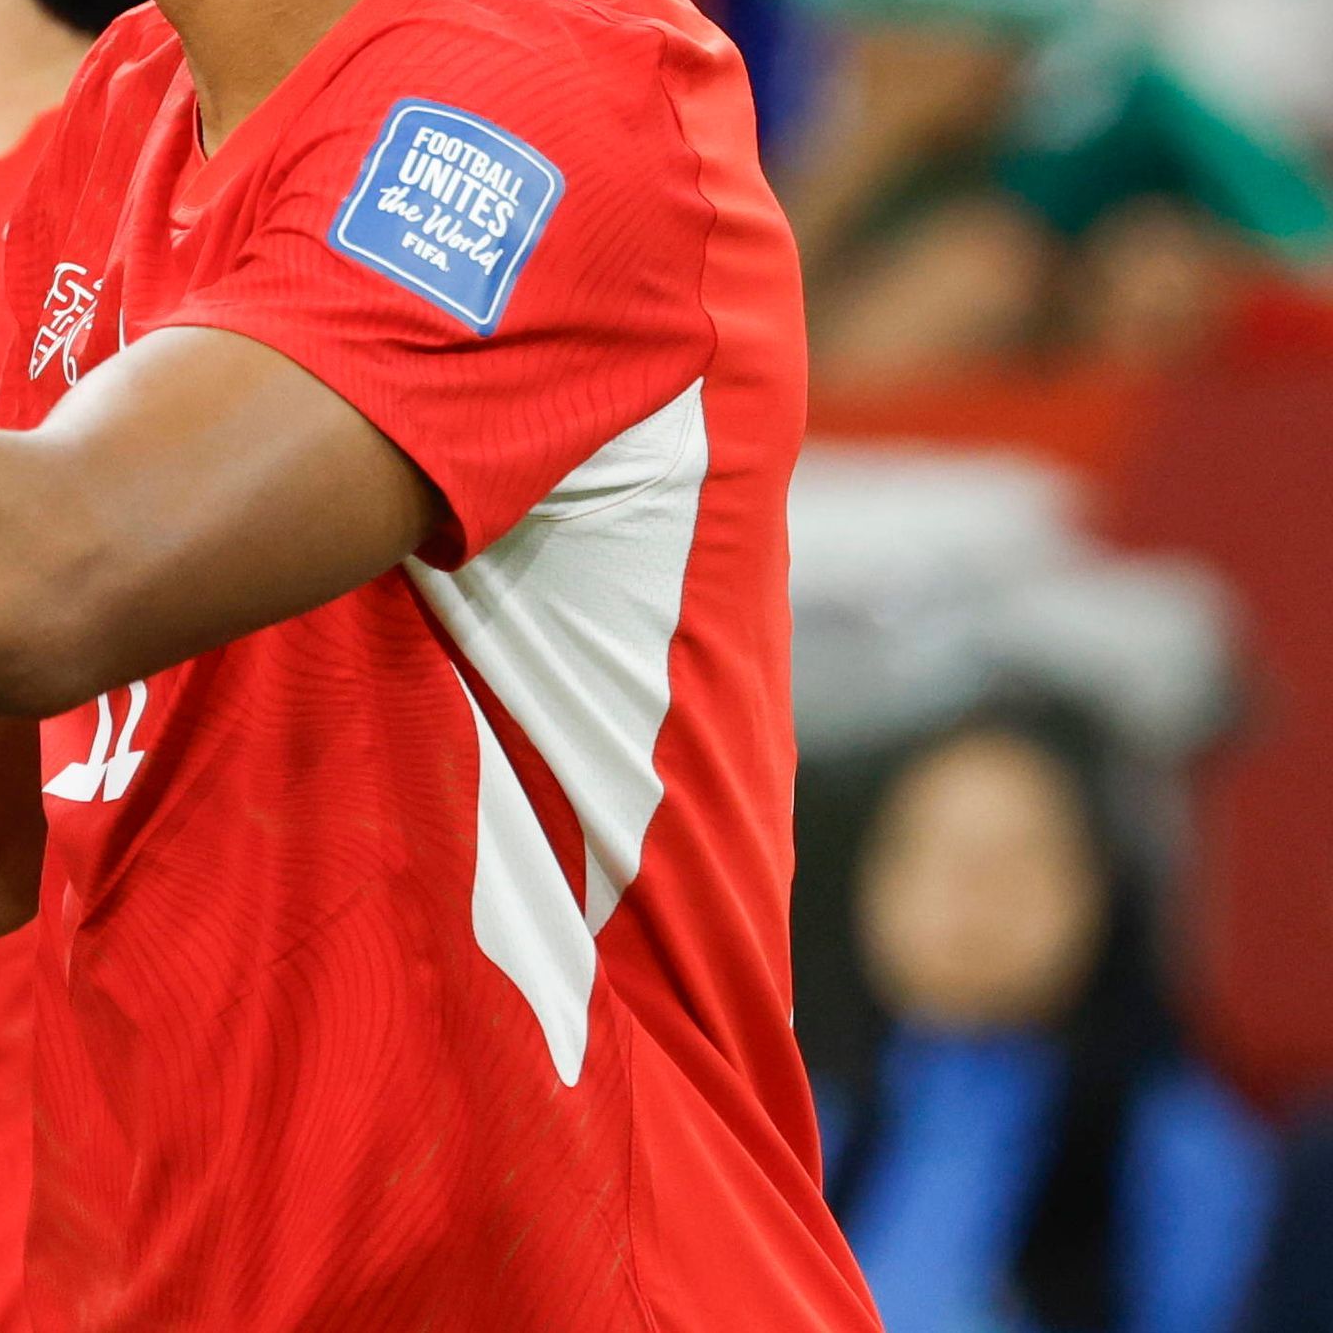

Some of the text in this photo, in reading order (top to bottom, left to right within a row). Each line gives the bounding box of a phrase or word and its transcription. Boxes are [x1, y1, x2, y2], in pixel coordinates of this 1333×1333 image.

[398, 148, 515, 238] UNITES
[412, 126, 523, 207] FOOTBALL
[378, 185, 504, 276] the World
[401, 231, 450, 272] FIFA
